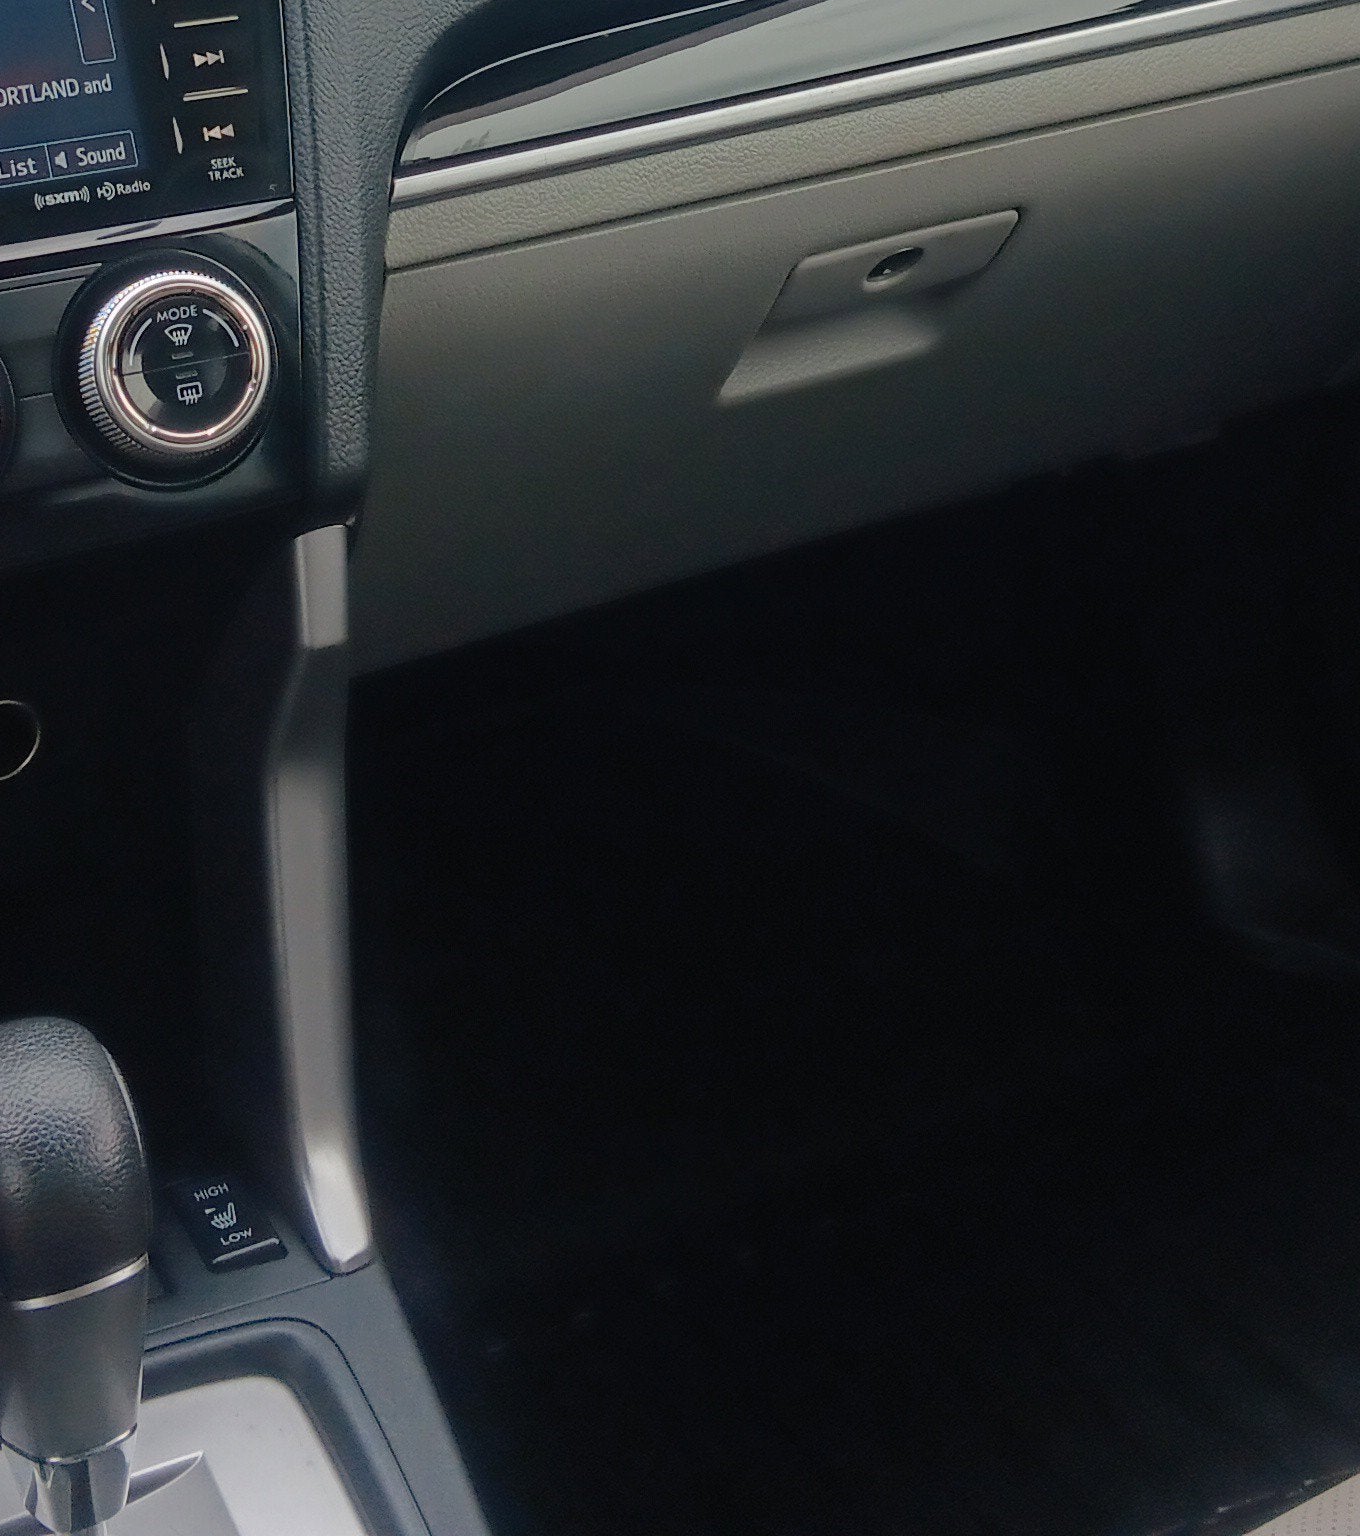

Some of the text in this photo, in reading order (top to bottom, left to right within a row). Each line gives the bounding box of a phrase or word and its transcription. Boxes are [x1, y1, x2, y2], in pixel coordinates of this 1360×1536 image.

[84, 73, 112, 96] and
[75, 141, 126, 168] Sound
[210, 156, 237, 170] SEEK
[207, 166, 245, 182] TRACK
[116, 179, 152, 196] Radio
[156, 304, 199, 324] MODE
[193, 1182, 229, 1202] HIGH
[220, 1227, 253, 1246] LOW
